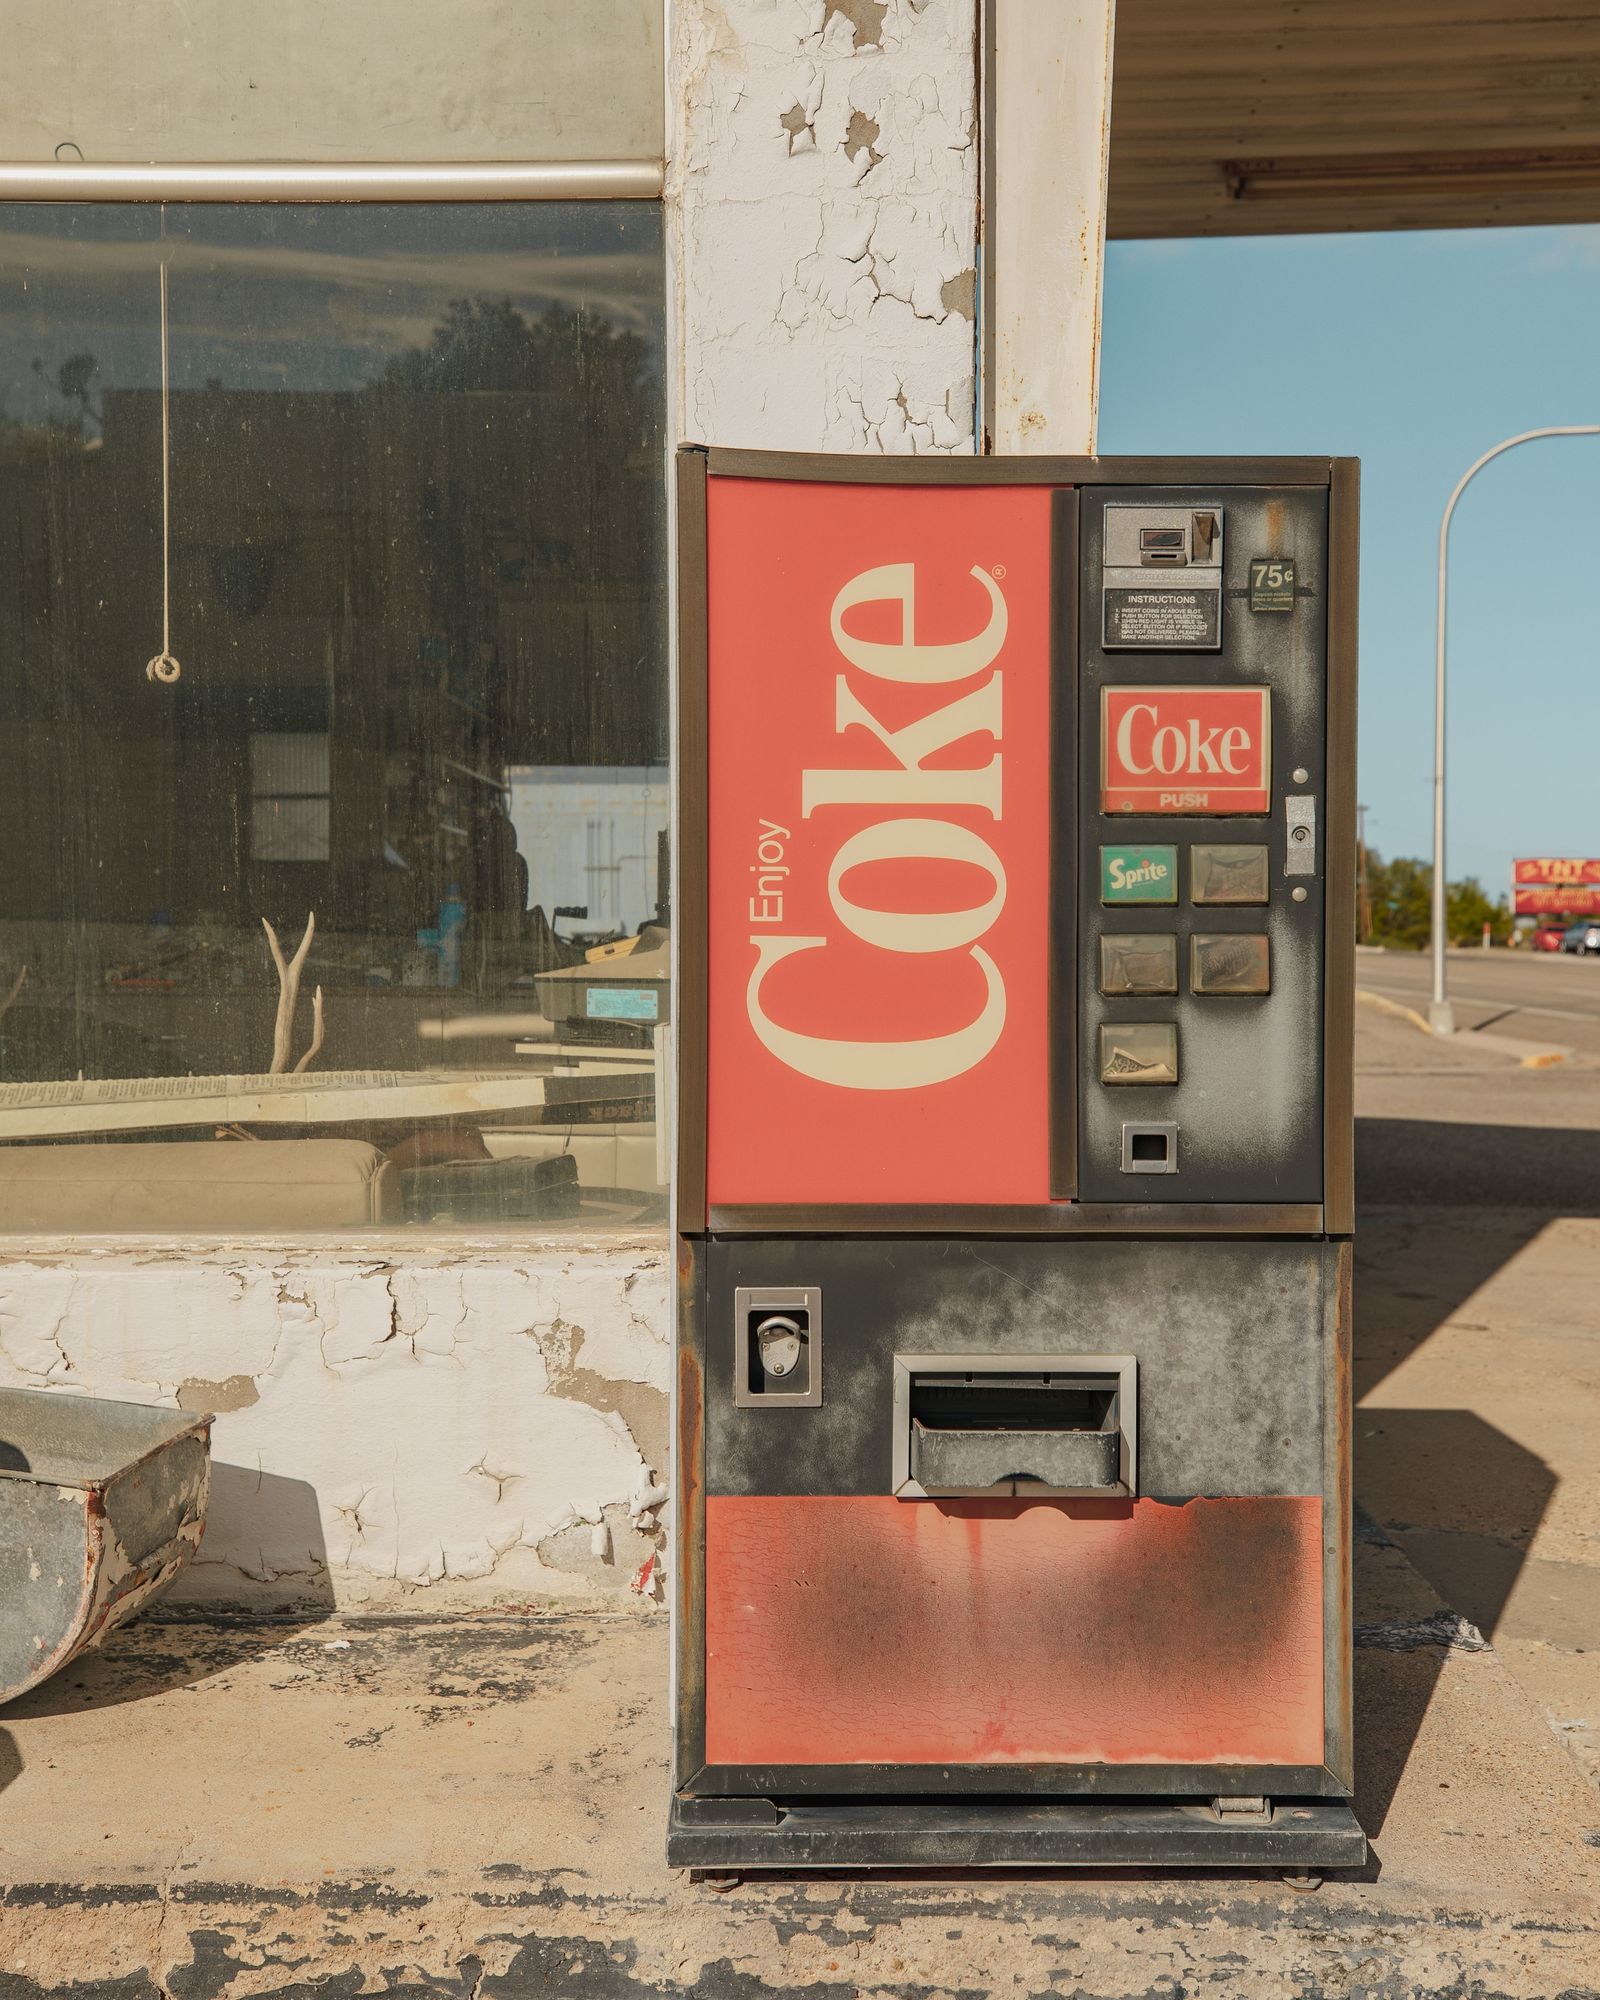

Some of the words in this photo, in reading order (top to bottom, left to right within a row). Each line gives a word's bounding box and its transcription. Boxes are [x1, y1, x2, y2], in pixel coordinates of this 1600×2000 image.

[1252, 565, 1293, 588] 75¢
[1128, 595, 1196, 604] INSTRUCTIONS
[1117, 704, 1251, 775] Coke
[1160, 793, 1209, 808] PUSH
[746, 562, 1008, 1090] Coke
[749, 818, 791, 923] Enjoy
[1109, 858, 1168, 889] Sprite
